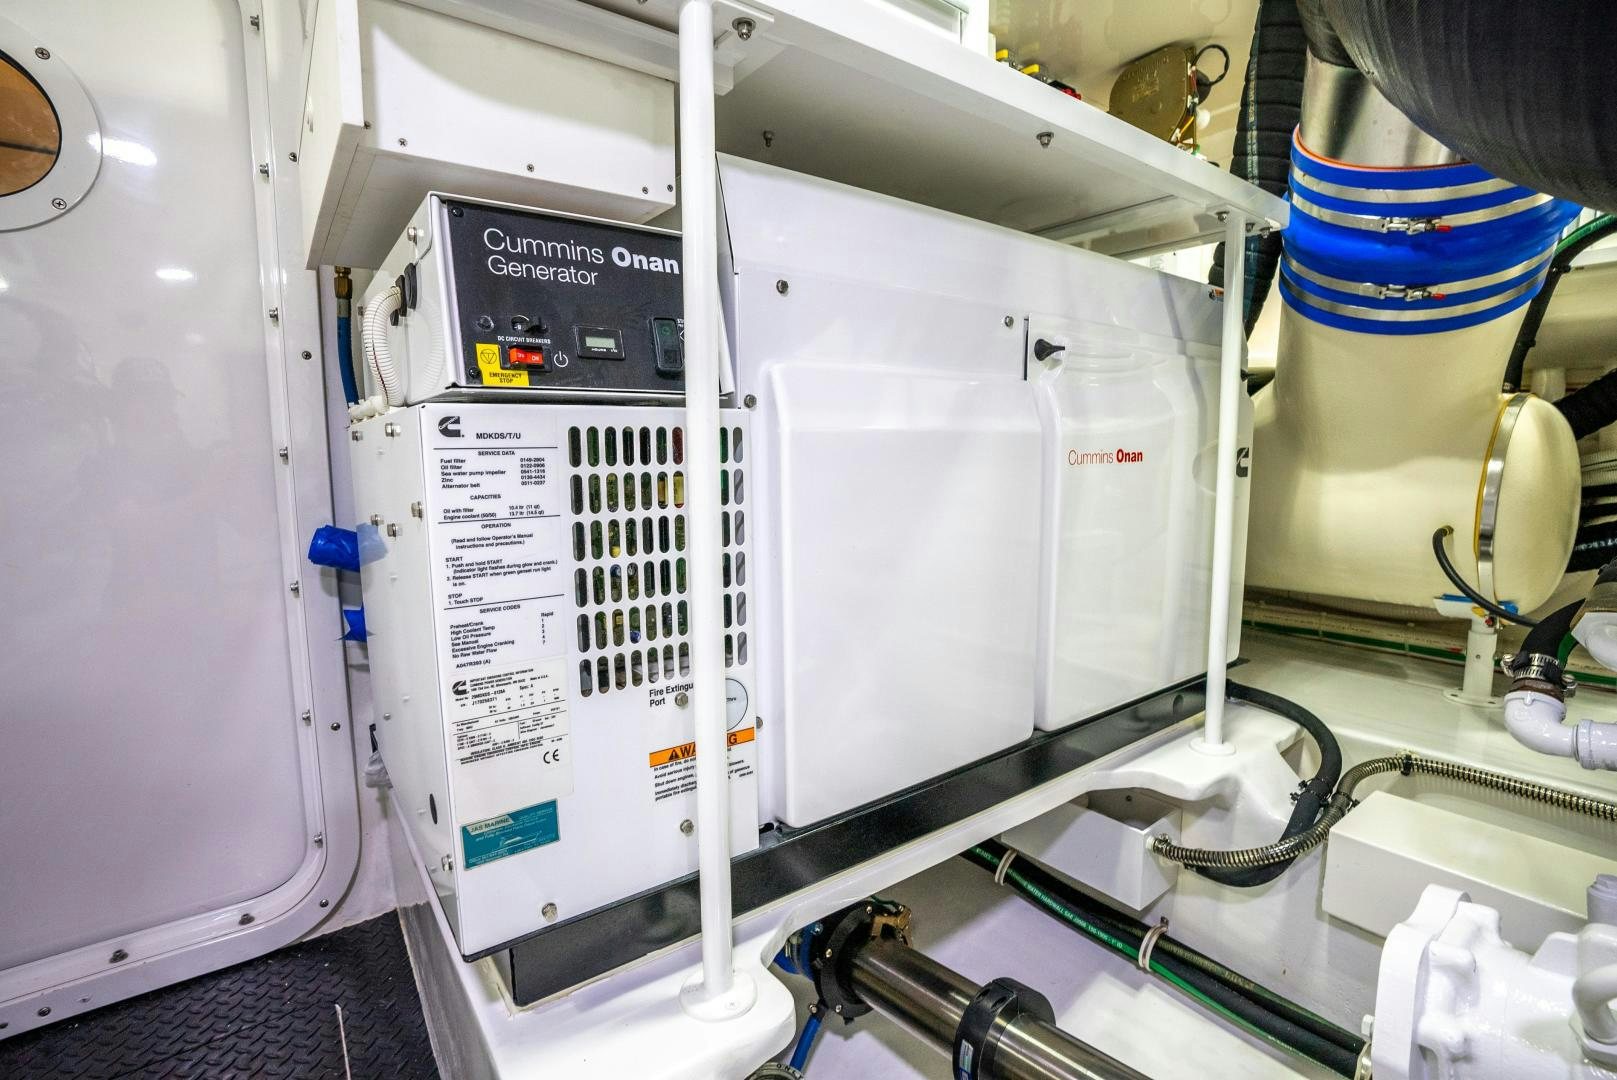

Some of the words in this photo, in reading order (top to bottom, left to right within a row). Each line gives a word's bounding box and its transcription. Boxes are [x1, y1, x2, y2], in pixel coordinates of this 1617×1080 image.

[483, 227, 604, 264] Cummins
[611, 246, 680, 275] Onan
[488, 255, 599, 286] Generator
[476, 432, 521, 440] MDKDS/T/U
[1068, 450, 1114, 466] Cummins
[1116, 448, 1143, 463] Onan
[649, 688, 664, 697] Fire
[666, 683, 694, 694] Extingu
[649, 697, 666, 707] Port
[1026, 883, 1042, 899] WATER
